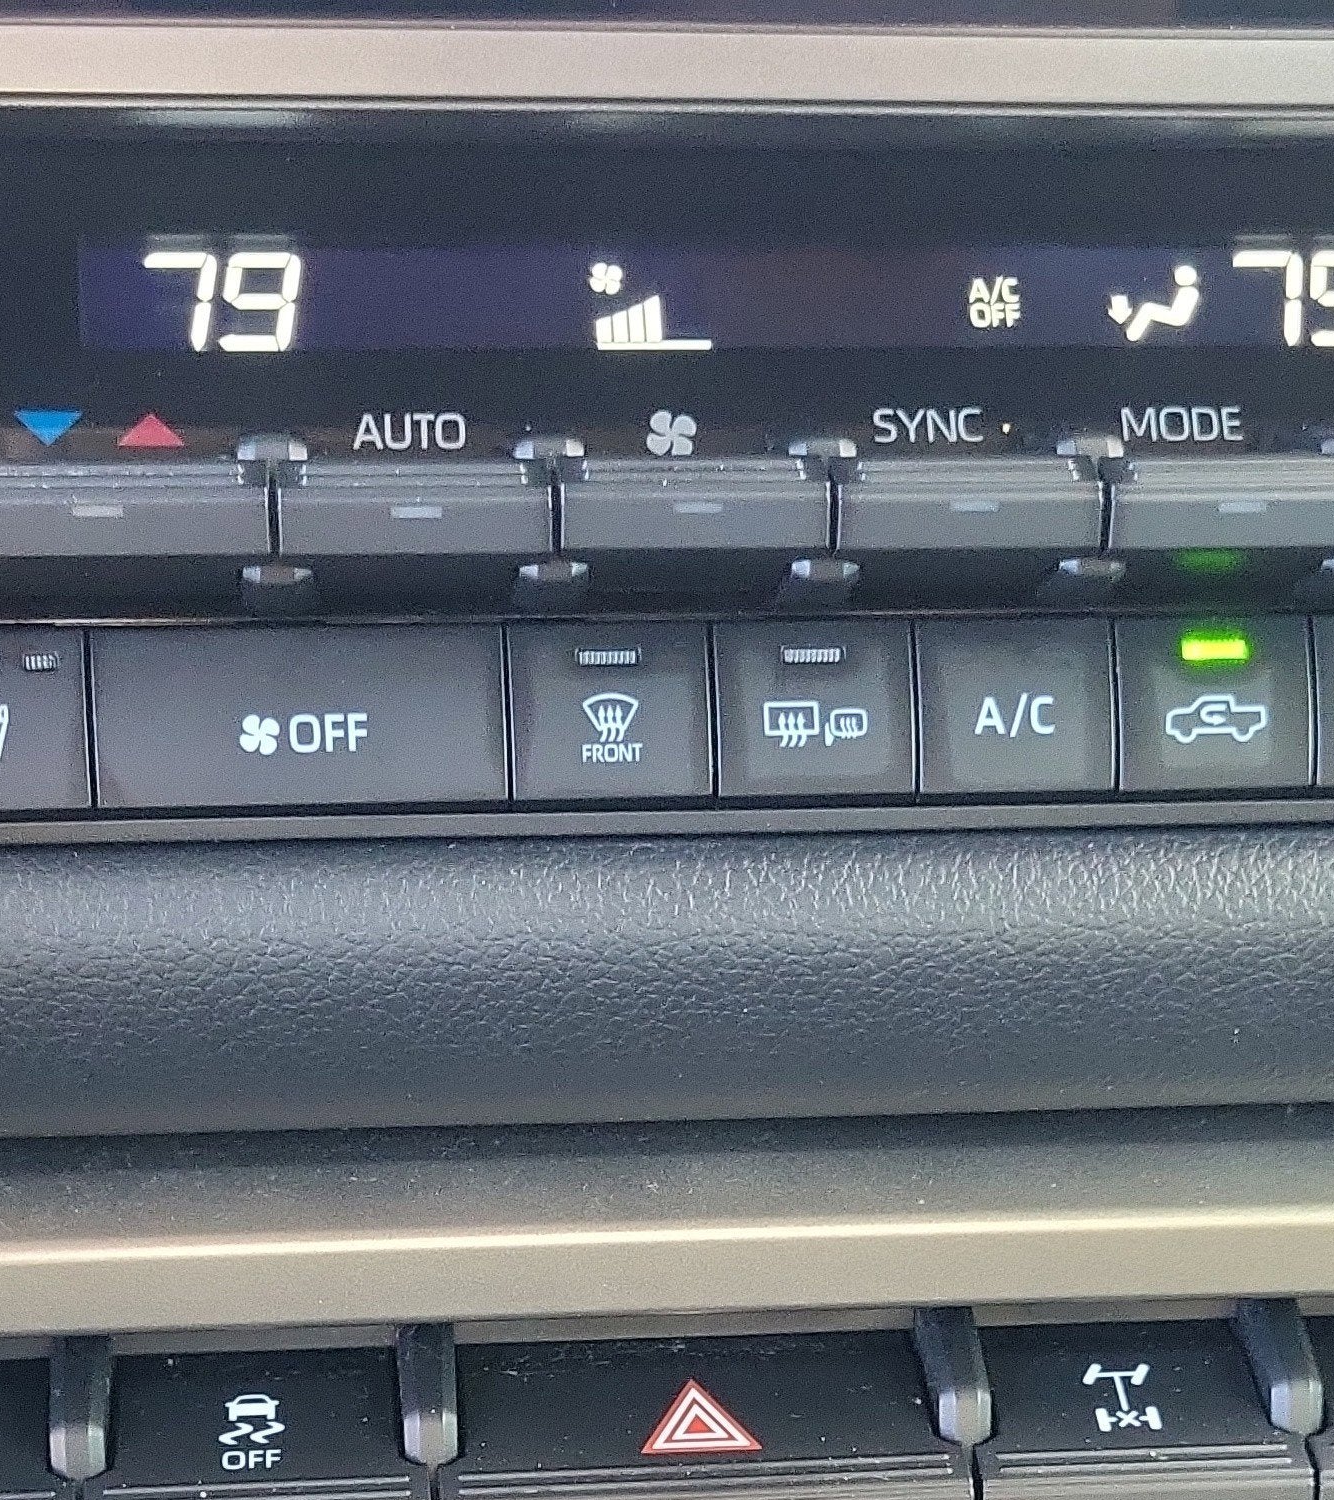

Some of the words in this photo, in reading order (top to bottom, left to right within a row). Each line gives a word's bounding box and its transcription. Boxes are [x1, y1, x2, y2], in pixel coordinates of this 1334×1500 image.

[143, 251, 302, 352] 79
[968, 275, 1021, 303] A/C
[969, 302, 1022, 328] OFF
[353, 412, 467, 451] AUTO
[872, 407, 984, 444] SYNC
[1121, 406, 1244, 443] MODE
[289, 712, 369, 752] OFF
[974, 694, 1057, 736] A/C
[581, 742, 643, 763] FRONT
[220, 1446, 282, 1470] OFF
